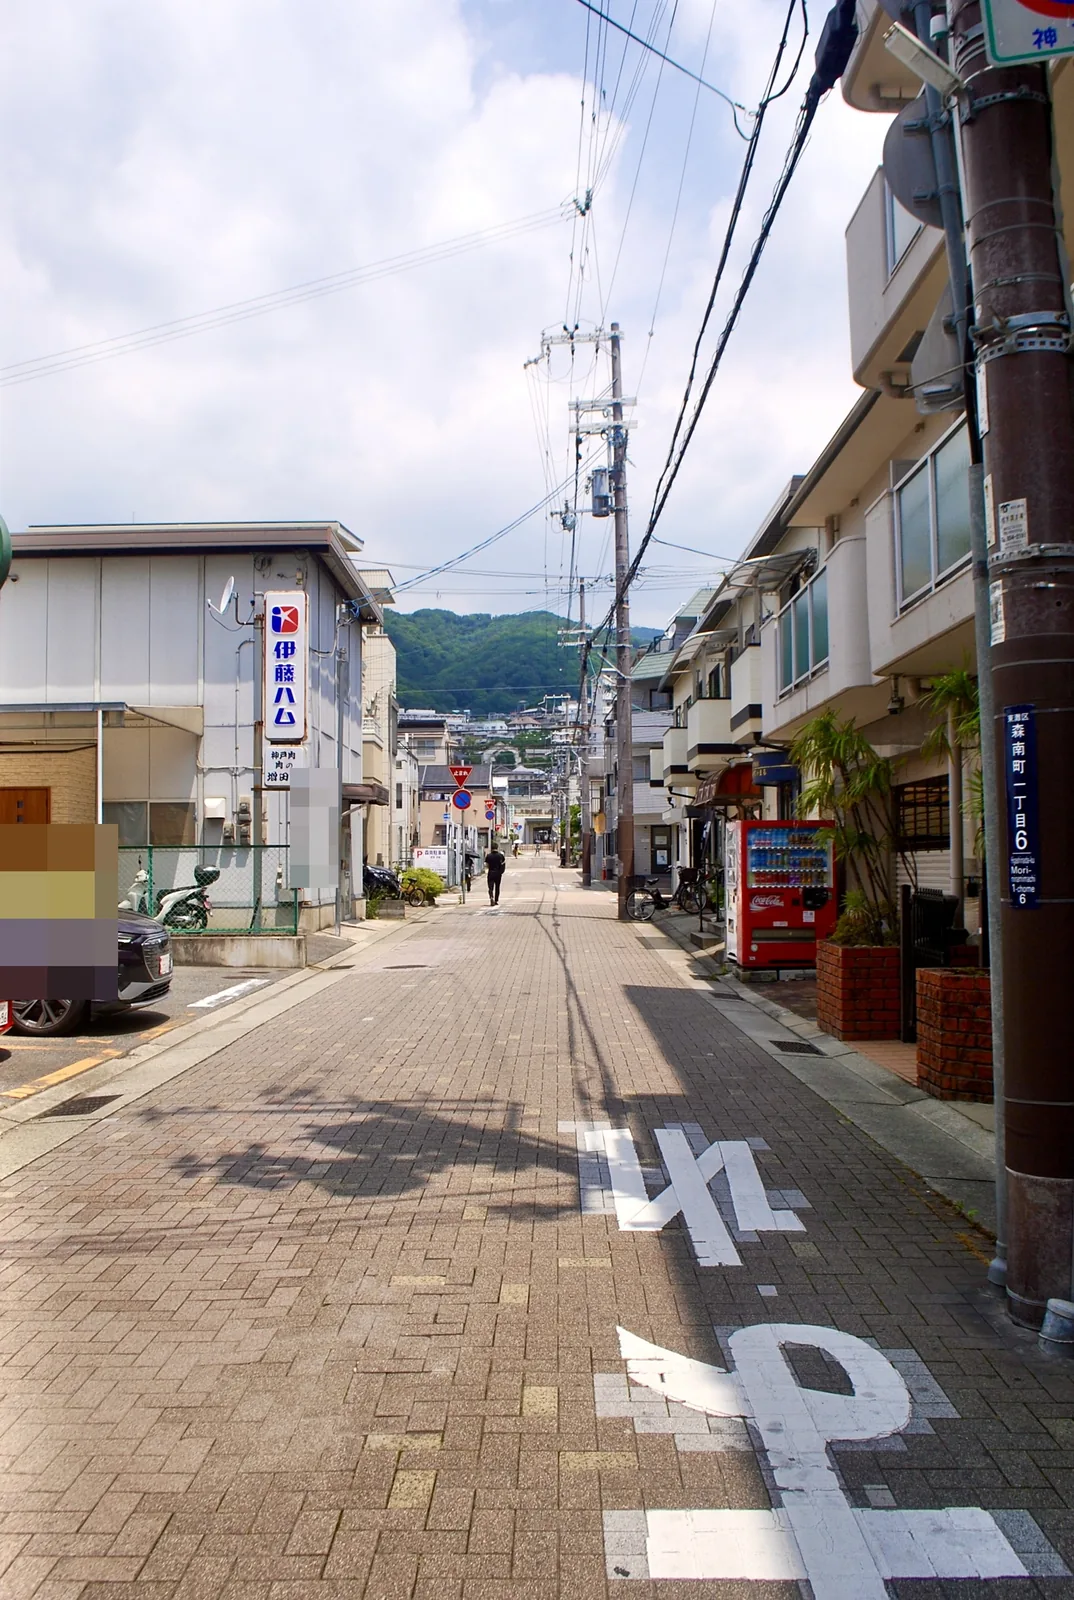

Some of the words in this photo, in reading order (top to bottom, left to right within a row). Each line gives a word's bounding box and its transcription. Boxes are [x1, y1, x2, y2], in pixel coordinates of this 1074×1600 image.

[1032, 24, 1074, 50] 神
[273, 640, 297, 726] 伊藤ハム
[416, 850, 423, 859] P
[1010, 866, 1032, 874] Mori-
[1011, 883, 1036, 893] 1-chome
[752, 894, 782, 906] Coca-Cola
[1019, 893, 1026, 904] 6
